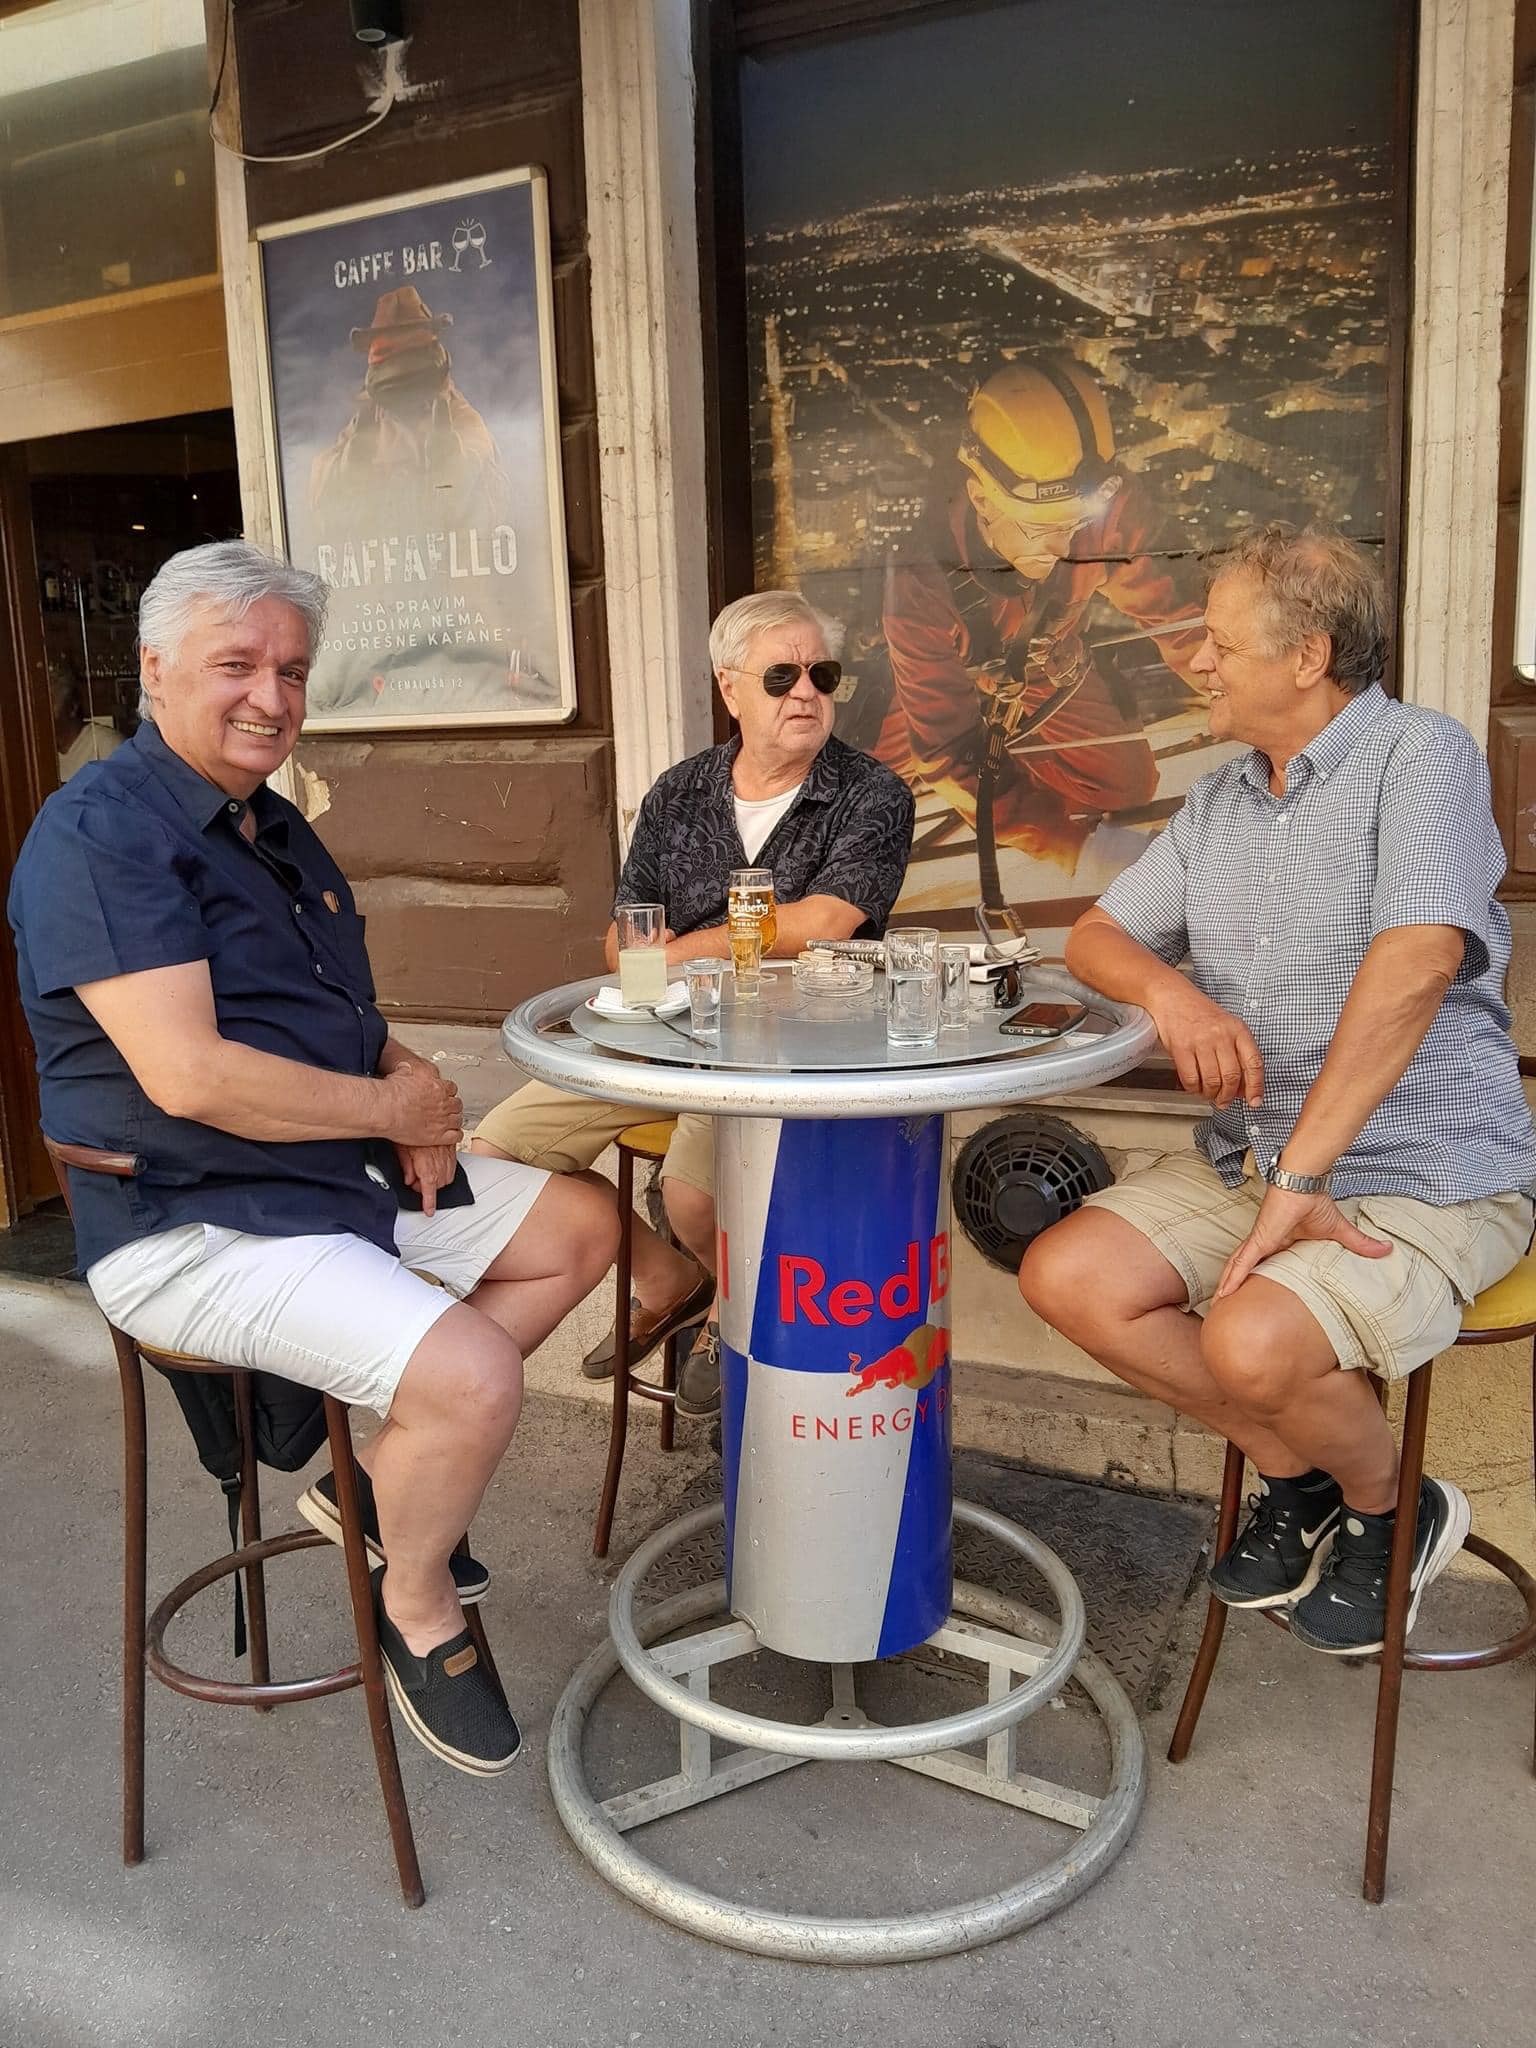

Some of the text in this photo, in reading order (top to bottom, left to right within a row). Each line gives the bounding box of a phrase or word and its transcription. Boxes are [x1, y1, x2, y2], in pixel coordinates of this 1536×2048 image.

[403, 241, 443, 275] BAR
[396, 595, 466, 614] PRAVIM
[342, 612, 486, 634] LJUDIMA NEMA
[322, 631, 418, 651] POGREŠNE
[793, 1398, 929, 1441] ENERGY
